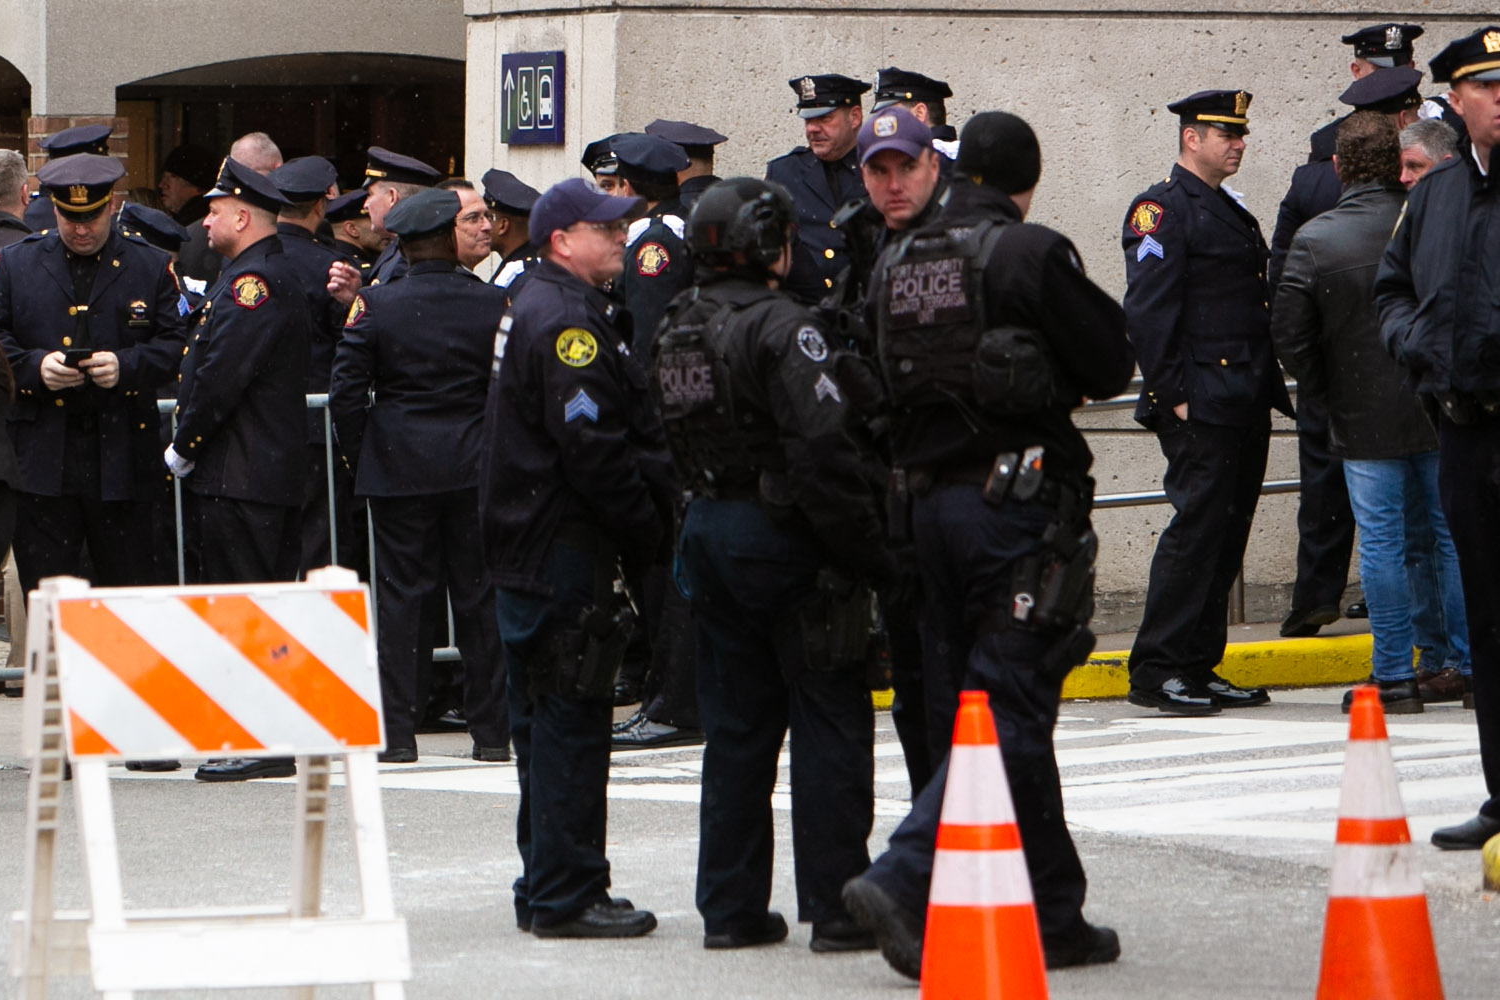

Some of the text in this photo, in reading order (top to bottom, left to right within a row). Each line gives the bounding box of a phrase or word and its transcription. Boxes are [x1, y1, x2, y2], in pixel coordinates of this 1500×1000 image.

[1147, 204, 1161, 214] CITY
[658, 248, 669, 262] CITY
[914, 257, 964, 276] AUTHORITY
[257, 282, 268, 296] CITY
[892, 272, 962, 300] POLICE
[659, 365, 714, 394] POLICE
